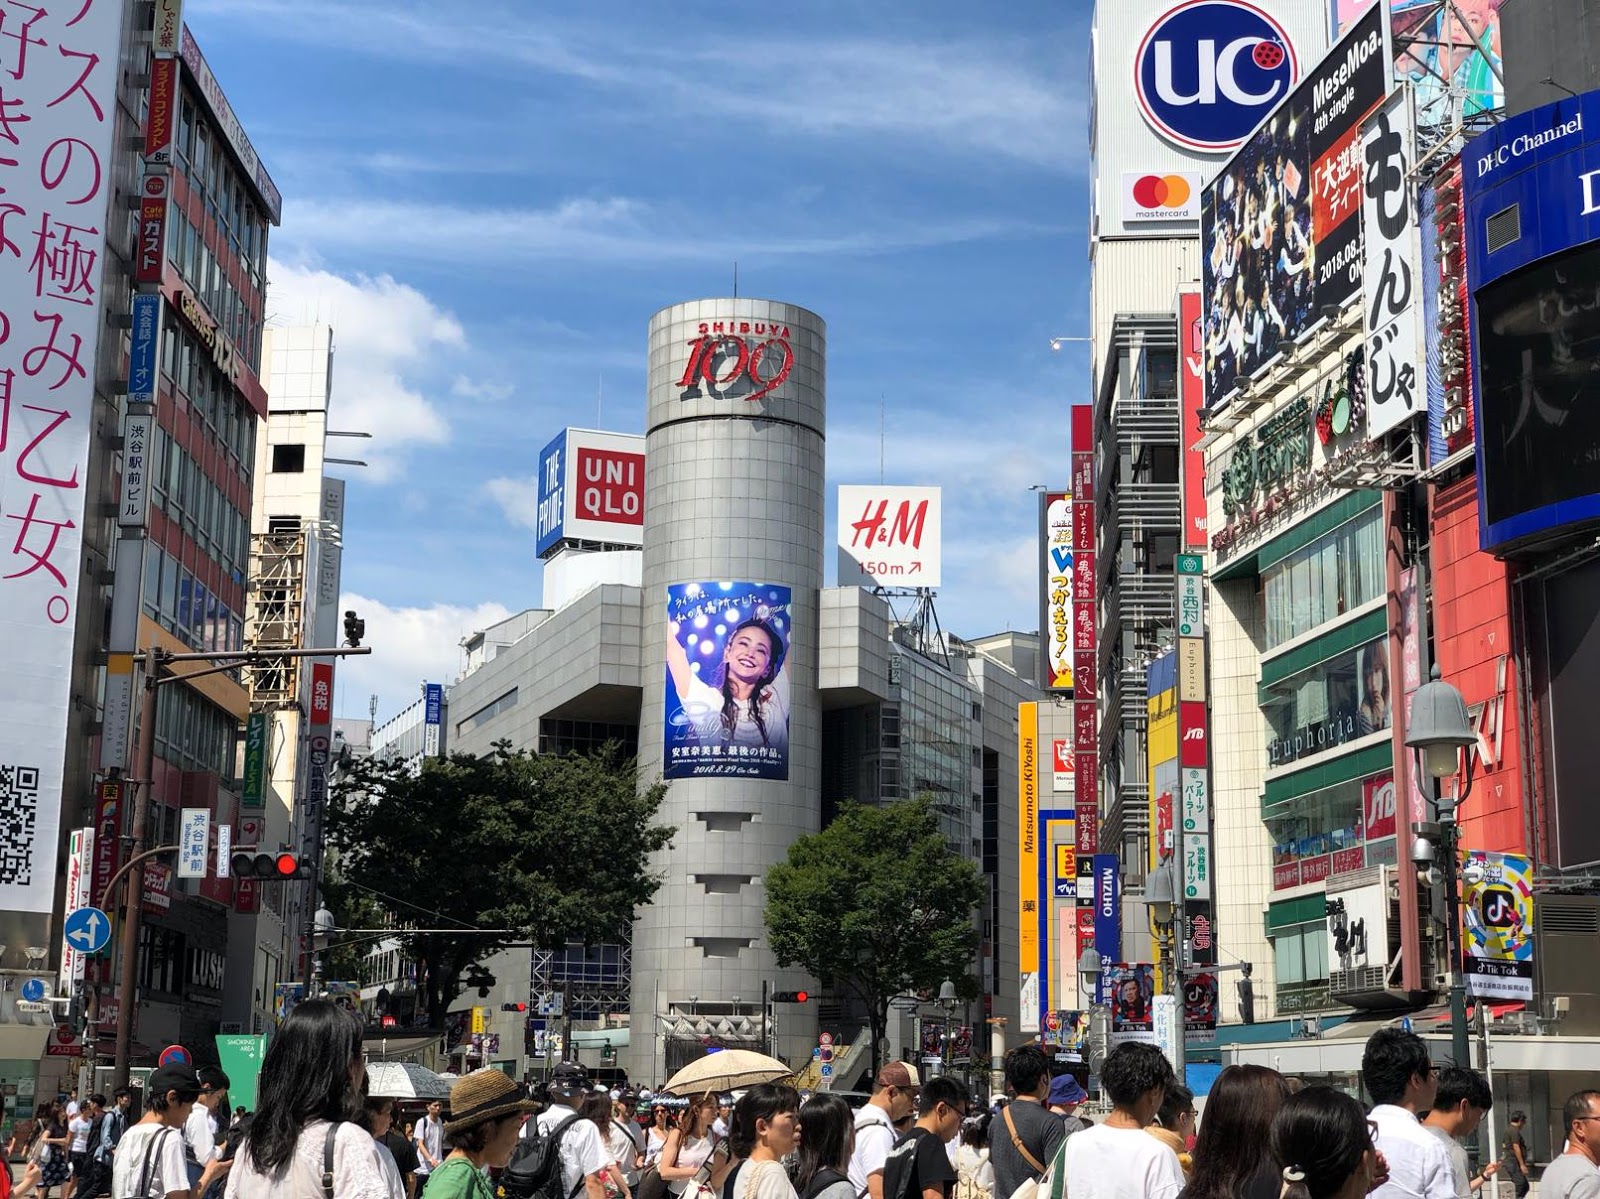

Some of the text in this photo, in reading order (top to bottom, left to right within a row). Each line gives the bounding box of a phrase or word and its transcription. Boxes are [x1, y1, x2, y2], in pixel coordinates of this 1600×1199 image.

[1154, 36, 1281, 106] UC
[1313, 30, 1382, 114] MeseMoa.
[1313, 86, 1355, 135] 4th single
[155, 152, 169, 161] 8F
[1477, 113, 1583, 178] DHC Channel
[144, 206, 163, 214] Café
[1136, 209, 1190, 218] mastercard
[143, 220, 161, 271] ガスト
[1365, 112, 1415, 411] もんじゃ
[3, 0, 104, 624] スの極み乙女。
[698, 322, 791, 338] SHIBUYA
[136, 305, 153, 392] 英会話イーオン
[674, 333, 795, 402] 109
[133, 393, 149, 402] 6F
[124, 424, 145, 516] 渋谷駅前ビル
[545, 449, 560, 495] THE
[584, 456, 635, 487] UNI
[538, 486, 563, 541] PRIME
[583, 486, 639, 516] QLO
[851, 499, 929, 550] H&M
[1182, 577, 1199, 624] 渋谷西村
[314, 680, 329, 711] 免税
[249, 717, 262, 750] レイク
[671, 744, 782, 759] 安室奈美恵、最後の作品。
[1183, 727, 1204, 741] JTB
[1271, 711, 1354, 762] Euphoria
[692, 764, 737, 774] 2018.8.29
[1024, 737, 1034, 854] Matsumoto KiYoshi
[1185, 785, 1194, 817] パーラー
[1195, 780, 1204, 813] フルーツ
[183, 823, 192, 851] Shibuya
[190, 813, 206, 872] 渋谷駅前
[1187, 851, 1195, 884] フルーツ
[1022, 900, 1036, 912] 薬
[1103, 867, 1114, 917] MIZUHO
[192, 948, 226, 990] LUSH
[1102, 954, 1113, 1009] みずほ銀行
[1501, 966, 1518, 976] Tok
[227, 1038, 256, 1046] SMOKING
